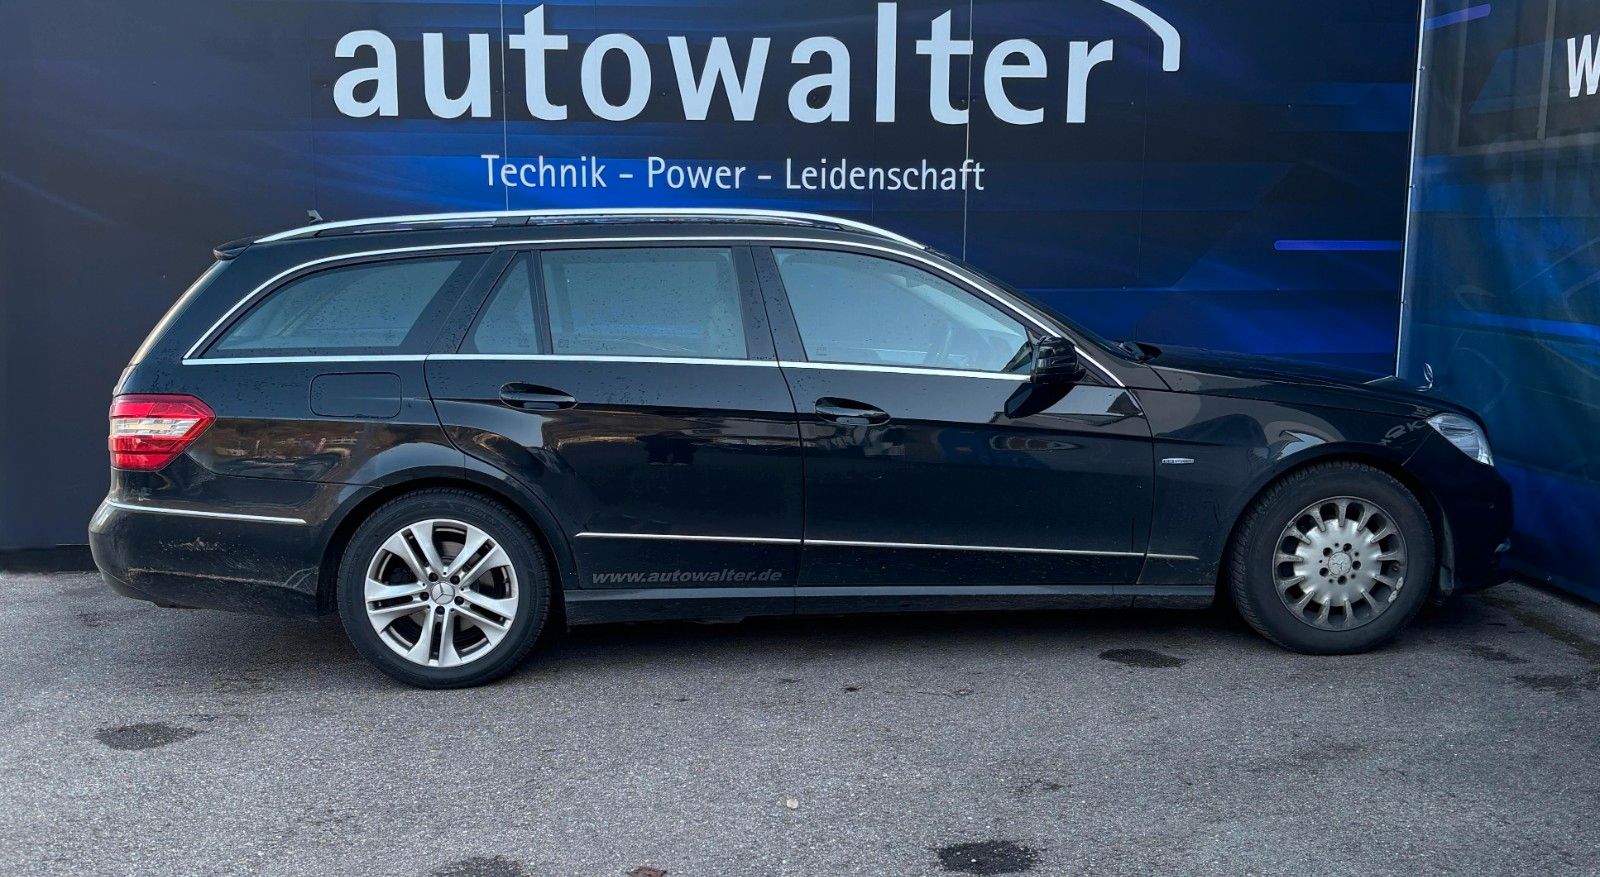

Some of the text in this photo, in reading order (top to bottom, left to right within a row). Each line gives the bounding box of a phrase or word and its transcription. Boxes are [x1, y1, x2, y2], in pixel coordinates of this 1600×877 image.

[333, 2, 1114, 125] autowalter
[480, 154, 607, 188] Technik
[647, 156, 746, 190] Power
[785, 158, 985, 191] Leidenschaft
[592, 568, 782, 584] www.autowalter.de
